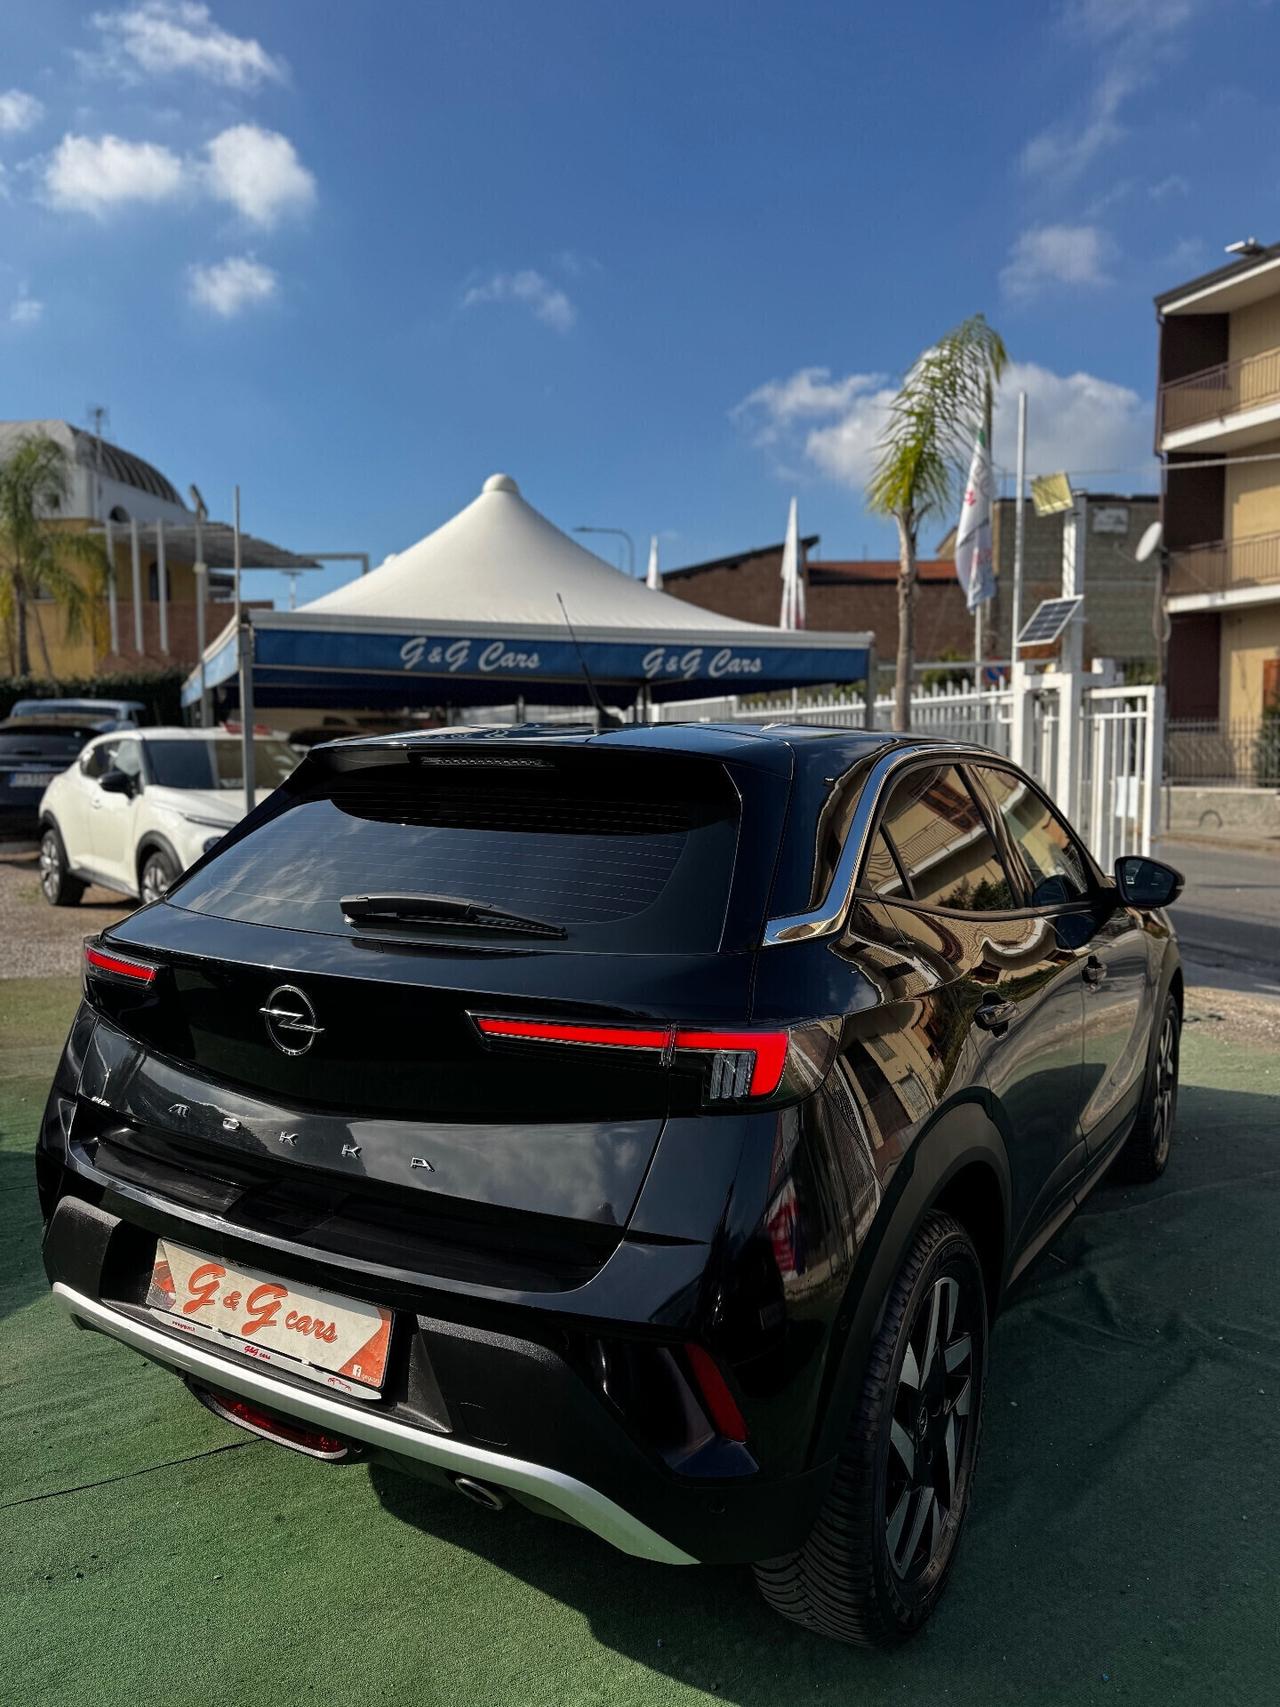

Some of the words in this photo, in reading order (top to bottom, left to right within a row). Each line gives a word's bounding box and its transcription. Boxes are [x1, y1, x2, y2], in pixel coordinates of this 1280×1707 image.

[478, 641, 540, 672] Cars
[708, 648, 763, 679] Cars
[167, 1102, 436, 1172] MOKKA
[285, 1310, 338, 1344] cars
